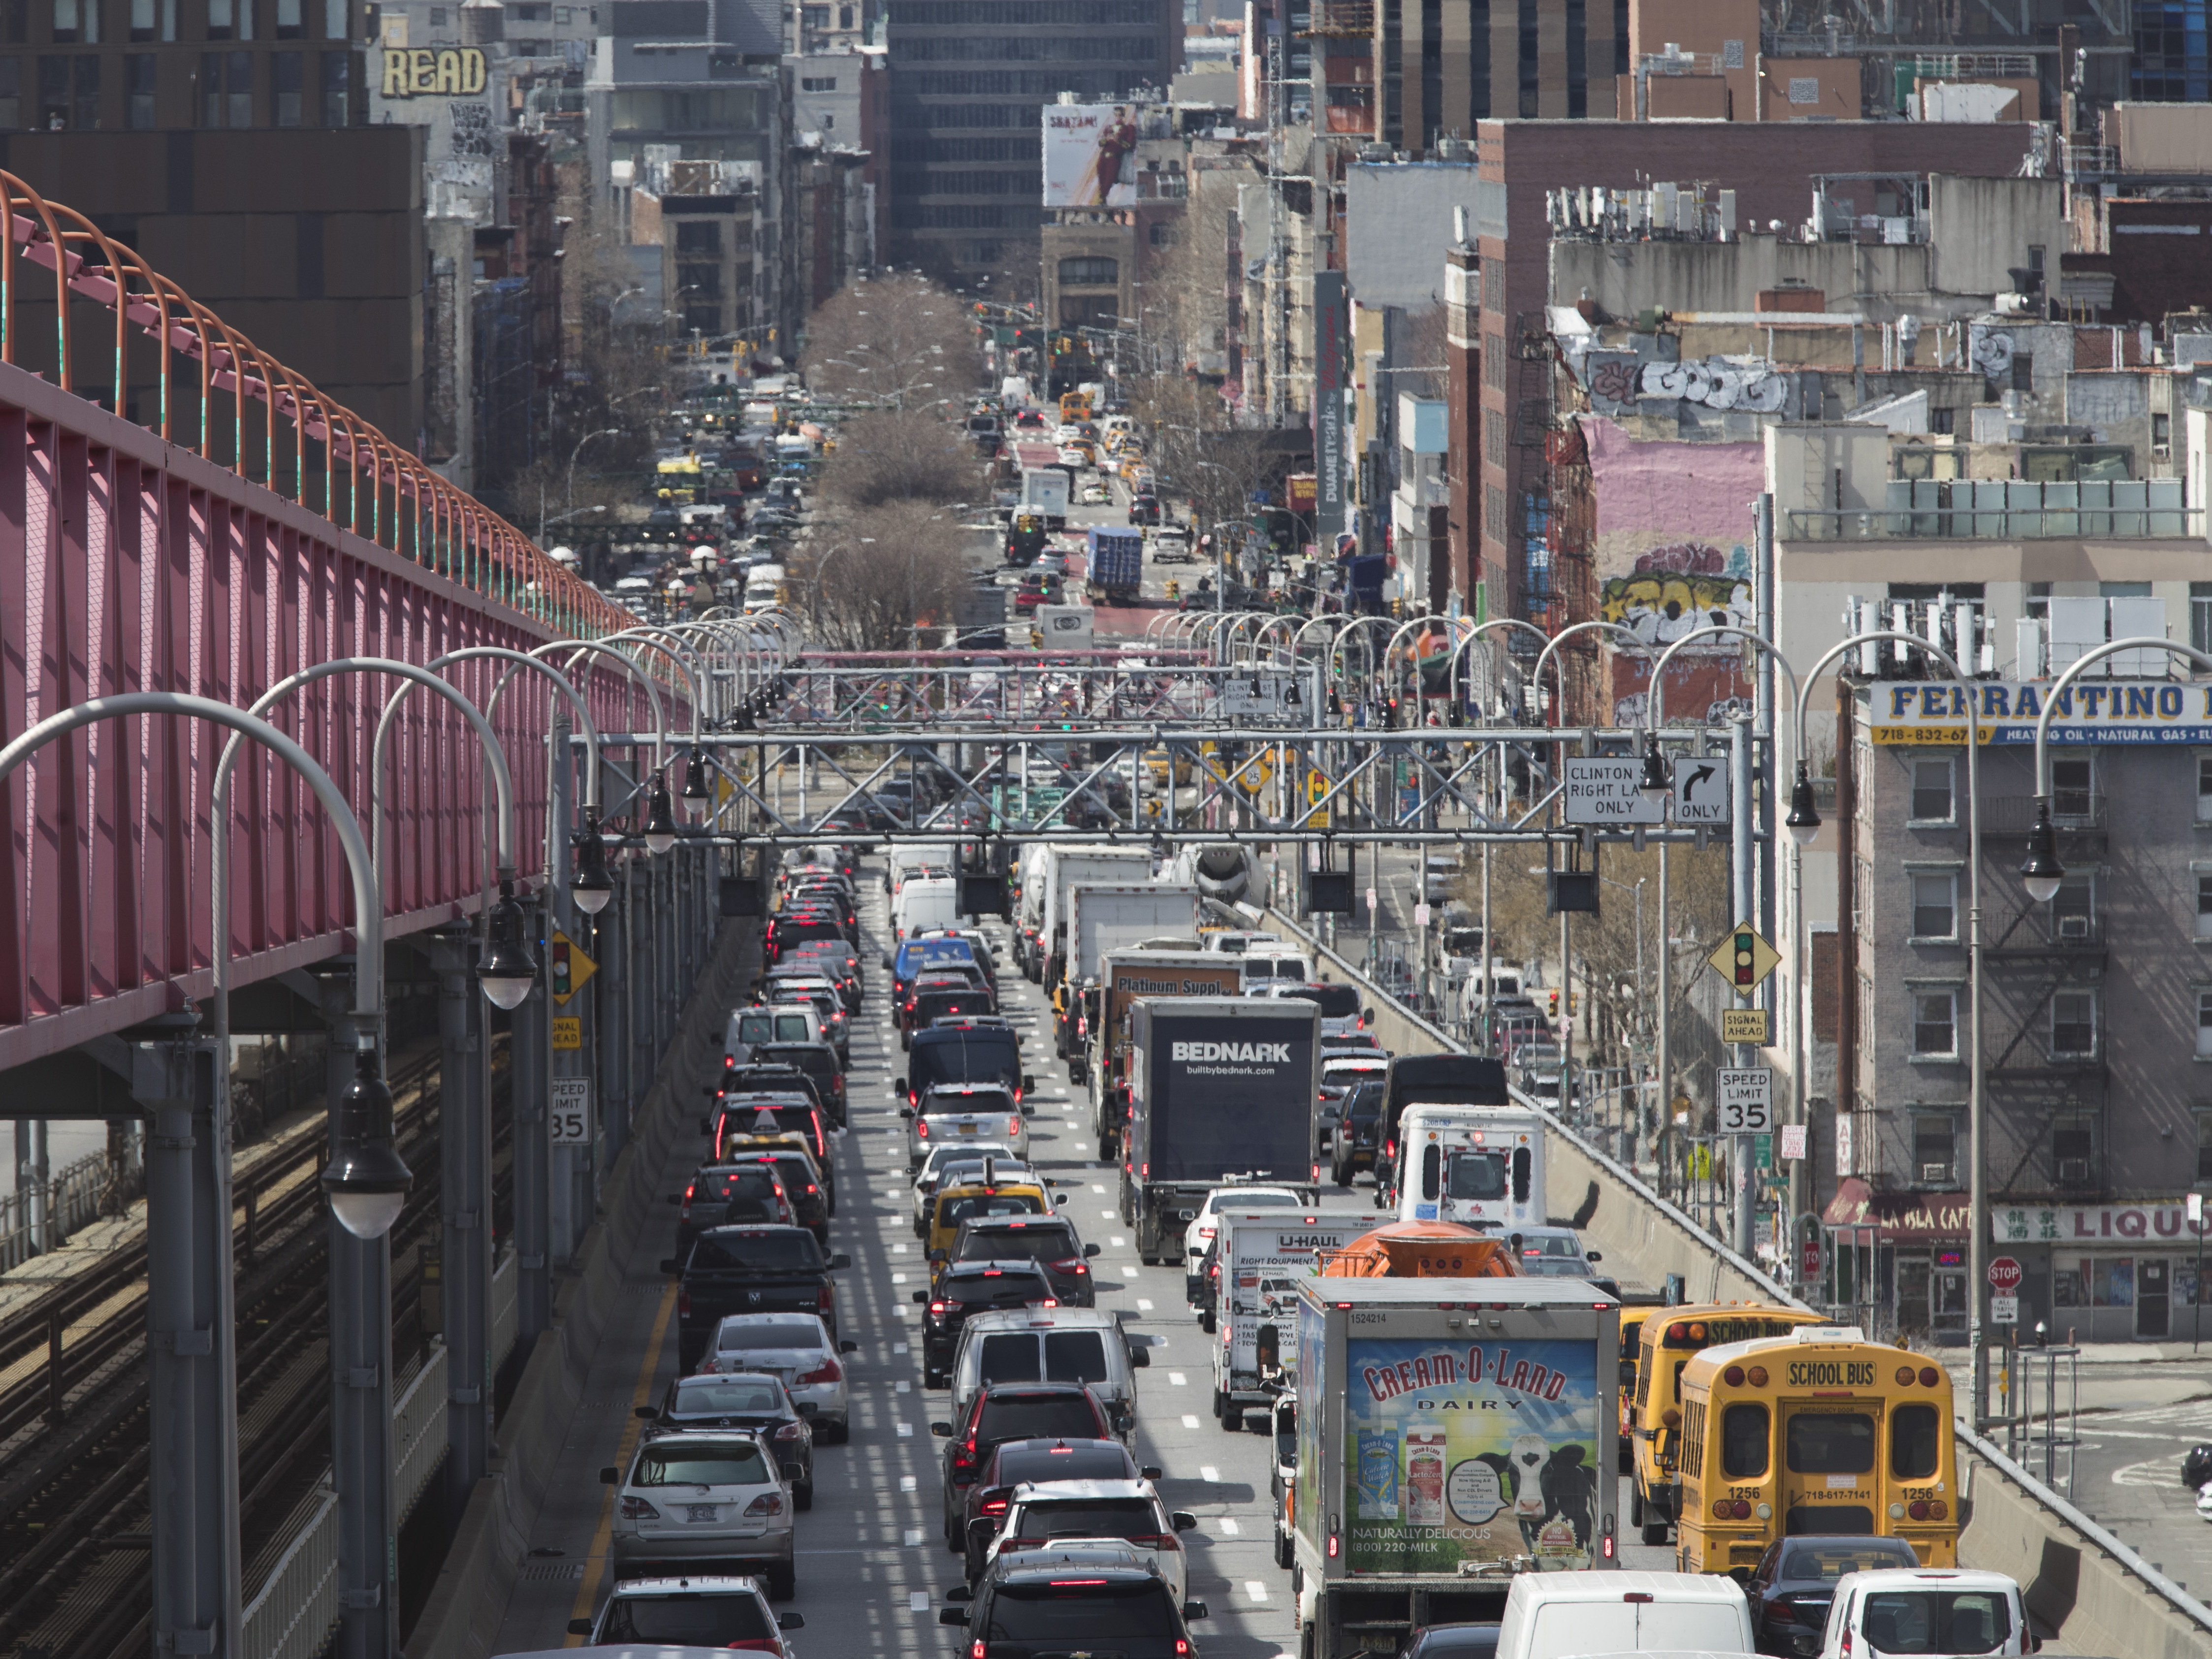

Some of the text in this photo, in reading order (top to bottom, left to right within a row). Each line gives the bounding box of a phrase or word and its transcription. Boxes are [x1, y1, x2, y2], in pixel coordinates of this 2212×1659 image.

[383, 48, 487, 97] READ
[1321, 305, 1341, 391] Walgreens
[1890, 686, 2183, 720] FERRANTINO
[1881, 729, 1986, 741] 718-832-670
[2065, 730, 2084, 740] OIL
[2097, 730, 2155, 741] NATURAL
[2162, 730, 2187, 740] GAS
[1571, 767, 1633, 780] CLINTON
[1571, 784, 1643, 797] RIGHT LA
[1596, 801, 1634, 814] ONLY
[1682, 805, 1720, 818] ONLY
[1118, 977, 1178, 993] Platinum
[1728, 1016, 1762, 1024] SIGNAL
[1728, 1027, 1763, 1036] AHEAD
[1173, 1042, 1291, 1062] BEDNARK
[1187, 1065, 1275, 1075] builtbybednark.com
[1723, 1075, 1767, 1085] SPEED
[553, 1085, 585, 1094] PEED
[1728, 1089, 1763, 1098] LIMIT
[554, 1098, 580, 1108] IMIT
[1726, 1104, 1766, 1128] 35
[1840, 1124, 1850, 1172] ATM
[1881, 1208, 1900, 1229] LA
[1991, 1267, 2019, 1279] STOP
[1351, 1313, 1386, 1324] 1524214
[1712, 1322, 1760, 1343] SCHOOL
[1789, 1363, 1874, 1385] SCHOOL BUS
[1417, 1400, 1524, 1410] DAIRY
[1729, 1487, 1760, 1499] 1256
[1806, 1491, 1870, 1499] 718-617-7141
[1902, 1488, 1933, 1499] 1256
[1353, 1528, 1491, 1539] NATURALLY DELICIOUS
[1353, 1543, 1438, 1552] (800) 220-MILK
